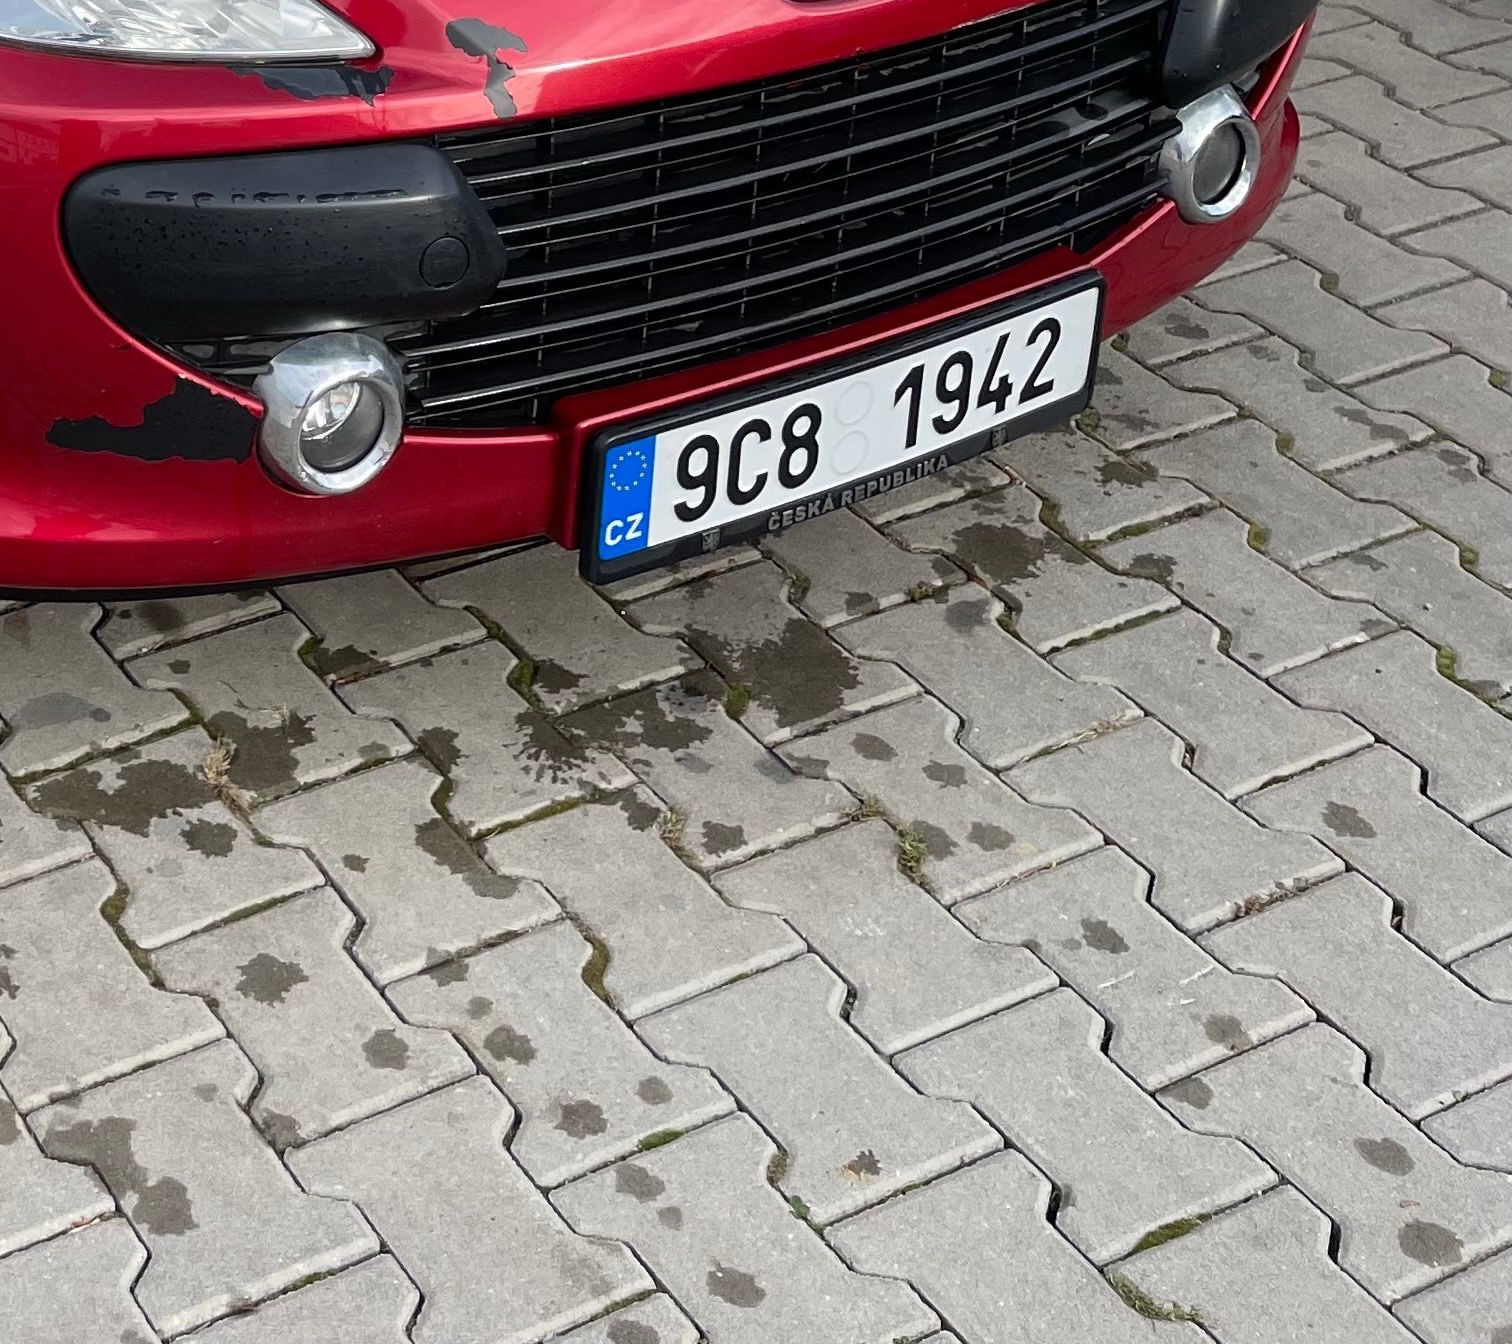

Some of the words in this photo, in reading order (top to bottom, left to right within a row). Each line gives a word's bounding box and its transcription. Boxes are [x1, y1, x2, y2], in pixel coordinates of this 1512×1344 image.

[604, 511, 645, 547] CZ
[673, 402, 822, 523] 9C8
[893, 316, 1062, 450] 1942
[768, 493, 835, 531] ČESKÁ
[840, 454, 949, 506] REPUBLIKA
